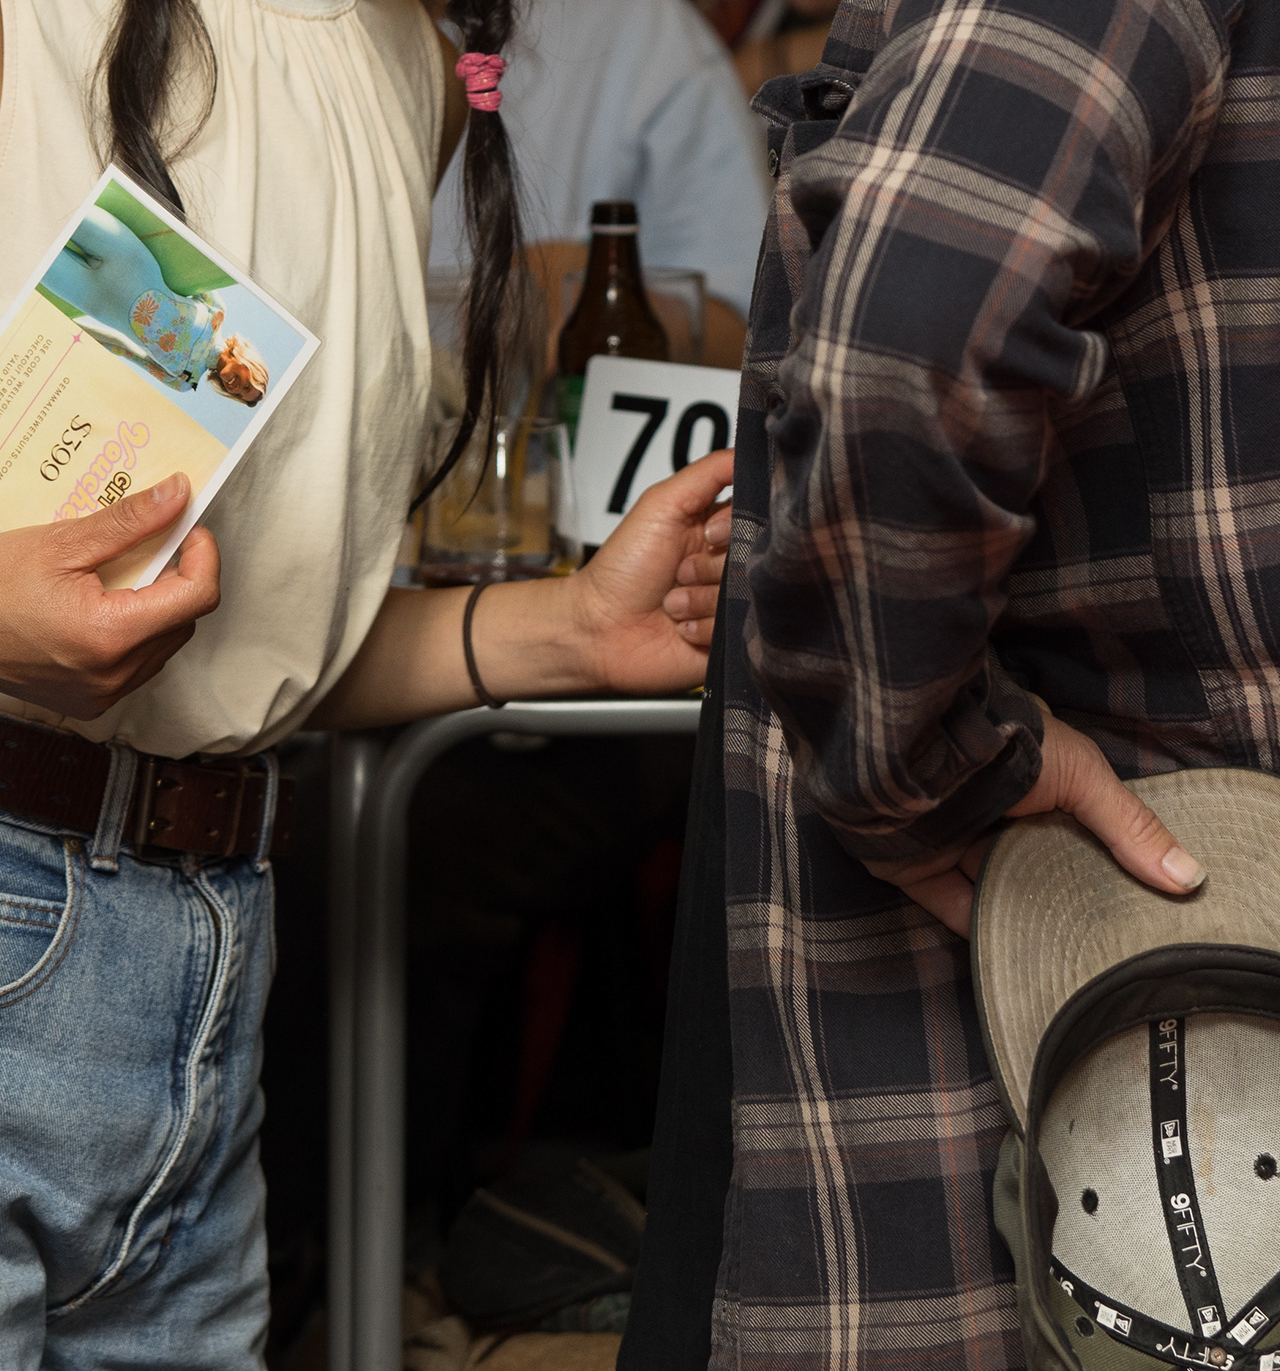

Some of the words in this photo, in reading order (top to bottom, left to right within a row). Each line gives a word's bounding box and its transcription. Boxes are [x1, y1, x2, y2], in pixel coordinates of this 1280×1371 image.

[14, 334, 44, 375] CHECKOUT
[39, 339, 53, 355] USE
[1, 353, 21, 376] VALID
[23, 355, 41, 378] CODE
[6, 375, 17, 387] TO
[39, 414, 93, 482] $399
[53, 421, 150, 522] Vouche
